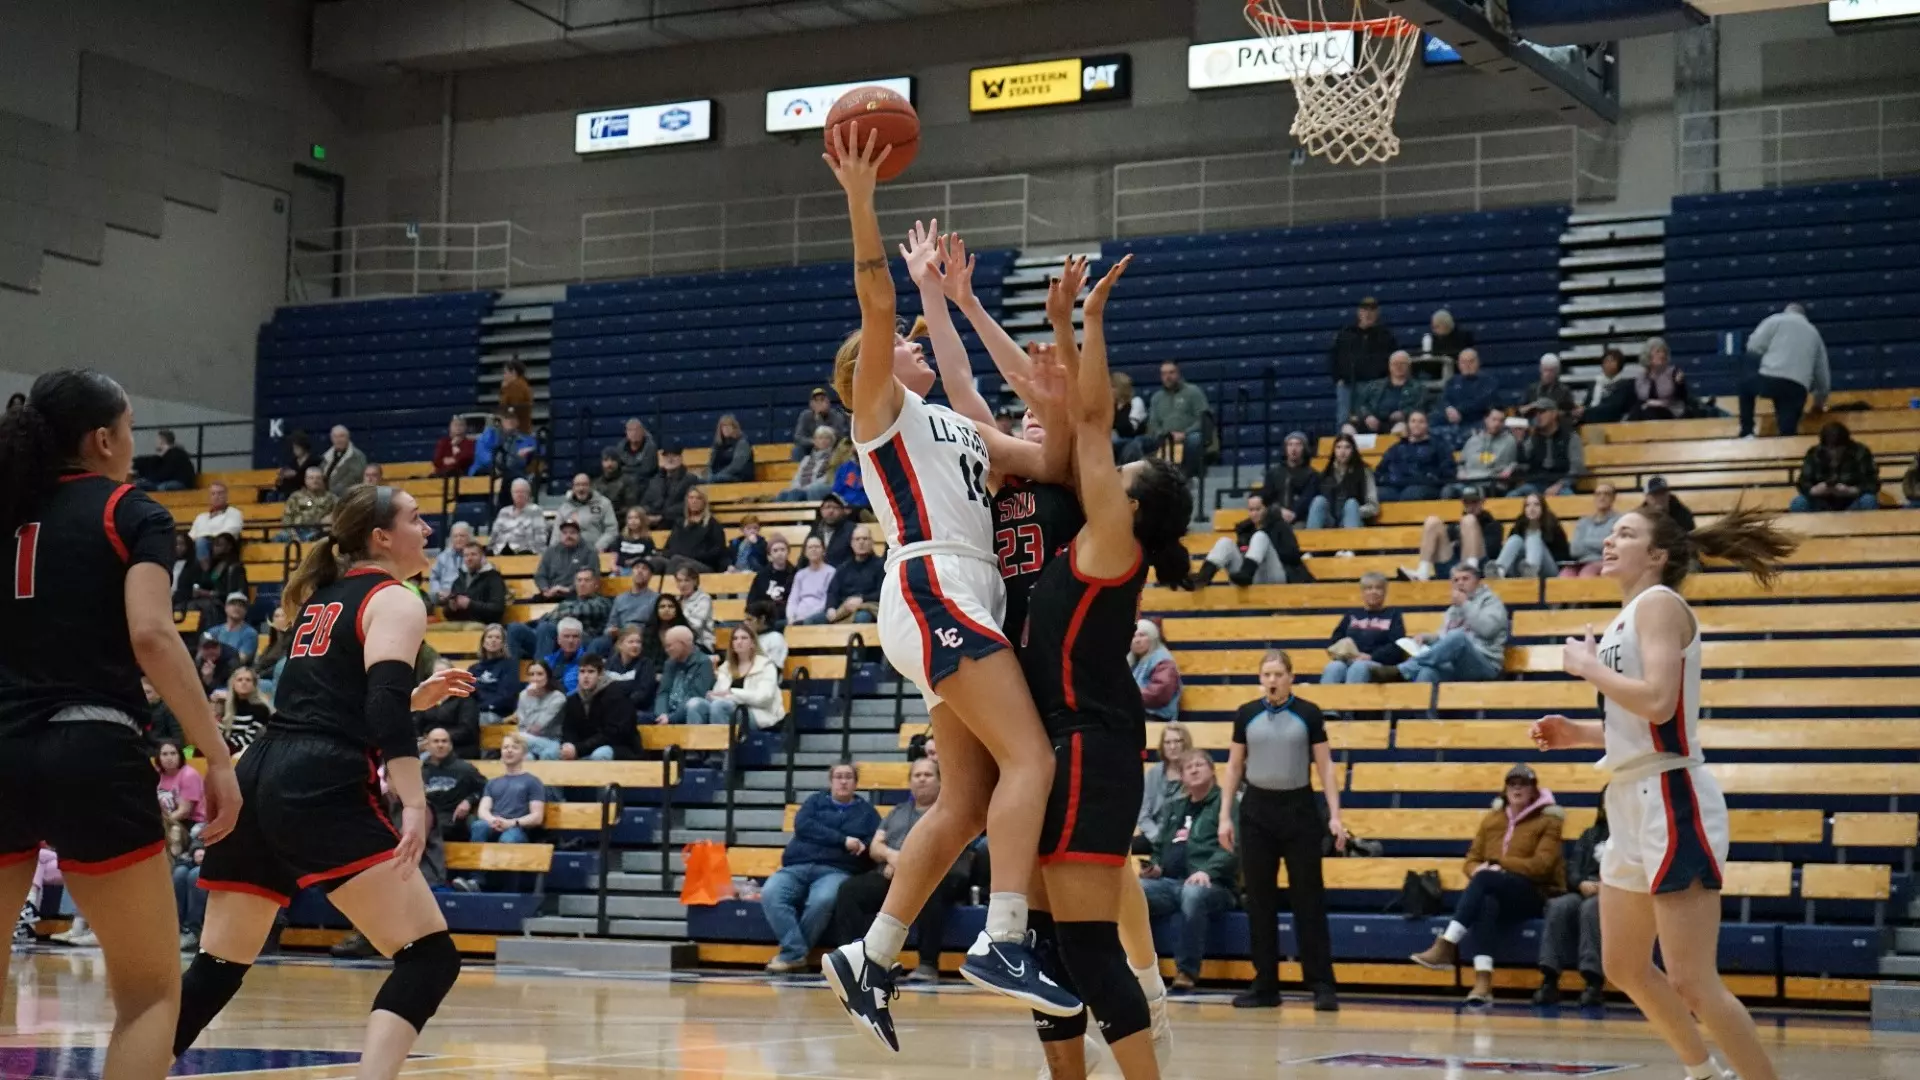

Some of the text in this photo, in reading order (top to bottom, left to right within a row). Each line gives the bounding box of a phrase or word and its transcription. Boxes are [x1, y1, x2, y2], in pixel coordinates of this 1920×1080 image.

[1238, 37, 1338, 68] PACIFIC
[1009, 85, 1050, 97] STATES
[1010, 71, 1067, 84] WESTERN
[1083, 64, 1120, 91] CAT
[270, 418, 284, 437] K
[928, 416, 957, 443] LC
[15, 522, 40, 599] 1
[996, 523, 1044, 580] 23
[290, 602, 343, 659] 20
[935, 628, 963, 648] LC
